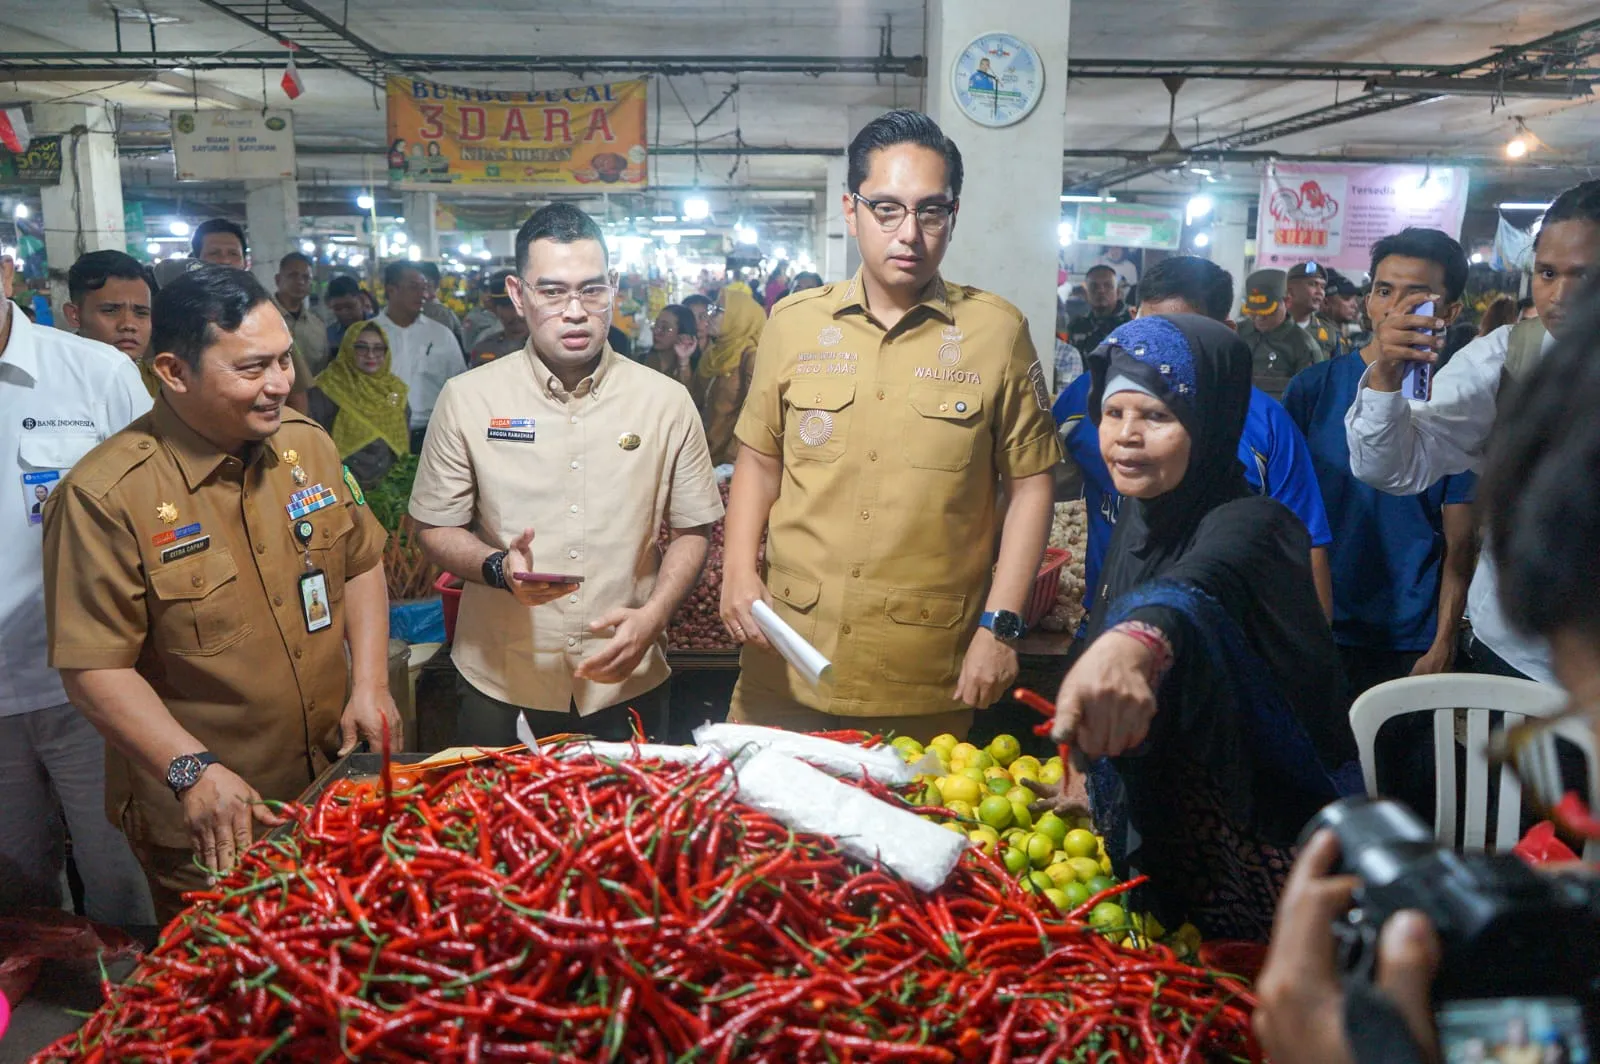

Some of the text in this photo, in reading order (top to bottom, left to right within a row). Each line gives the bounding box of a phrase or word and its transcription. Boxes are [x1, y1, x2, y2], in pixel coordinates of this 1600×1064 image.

[527, 83, 618, 103] PECAL
[419, 104, 616, 143] 3 DARA
[1351, 185, 1396, 196] Tersedia
[914, 366, 981, 384] WALIKOTA
[37, 419, 95, 428] BANK INDONESIA
